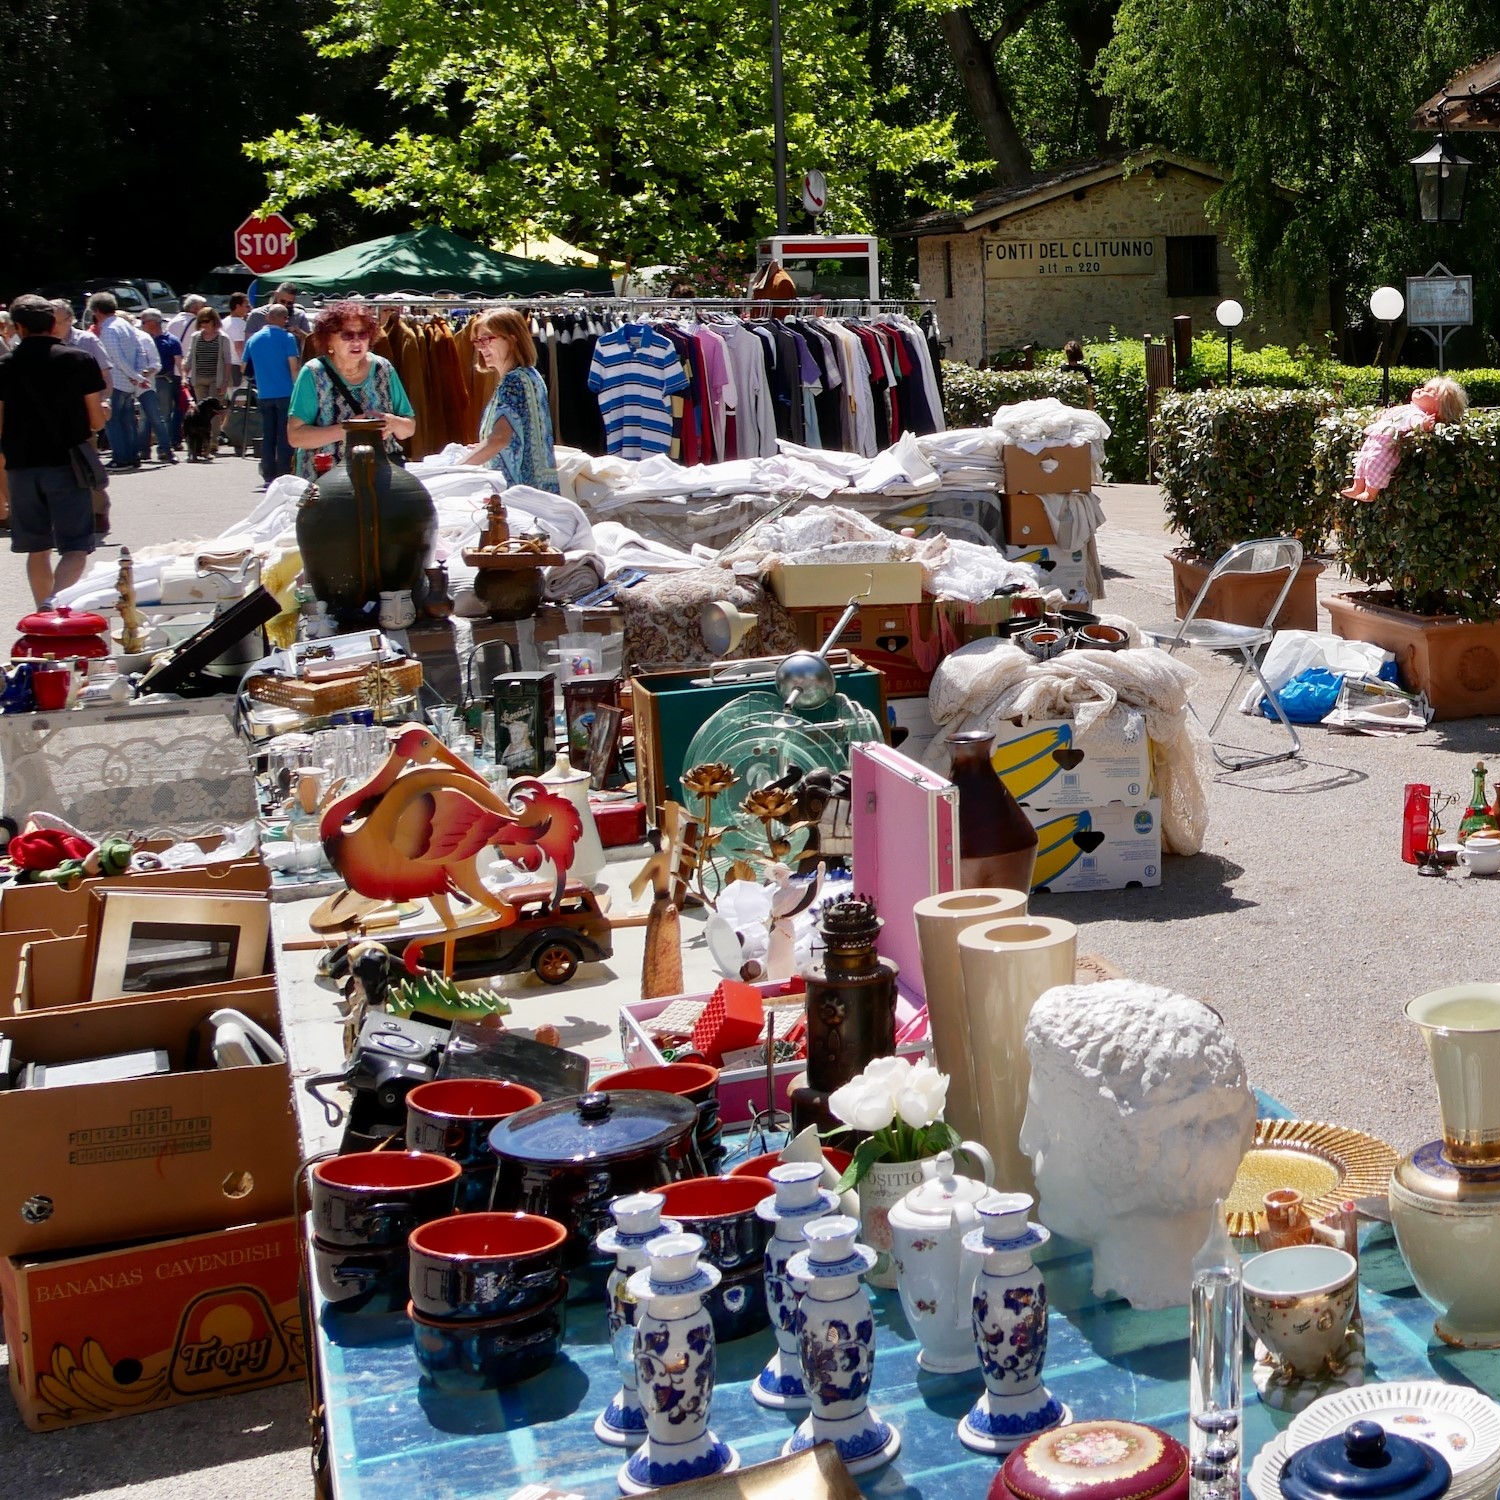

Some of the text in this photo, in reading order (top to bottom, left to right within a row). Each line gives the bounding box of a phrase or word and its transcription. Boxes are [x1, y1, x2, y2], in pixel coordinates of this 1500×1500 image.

[240, 233, 292, 255] STOP
[986, 241, 1153, 260] FONTI DEL CLITUNNO
[1078, 262, 1100, 273] 220
[823, 616, 861, 632] De
[867, 1171, 923, 1187] OSITIO
[35, 1268, 143, 1302] BANANAS
[155, 1241, 281, 1280] CAVENDISH
[180, 1335, 272, 1376] Tropy
